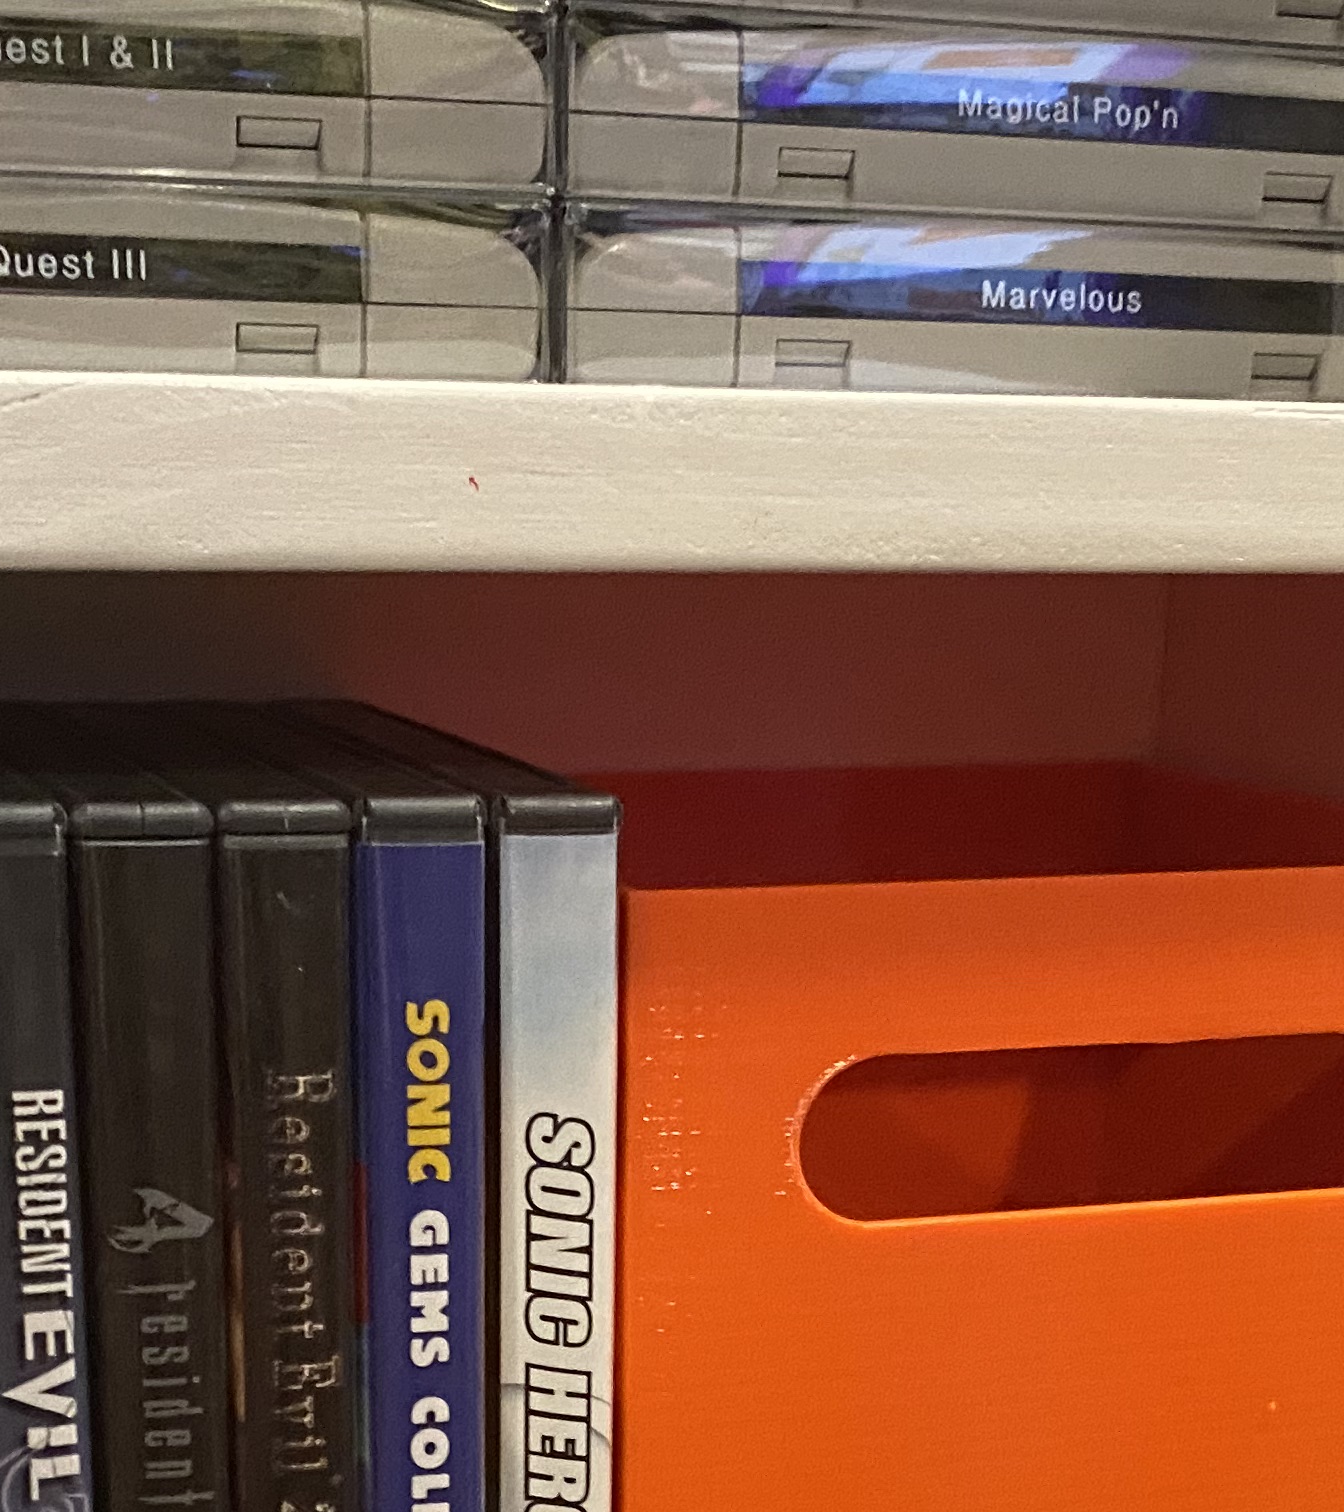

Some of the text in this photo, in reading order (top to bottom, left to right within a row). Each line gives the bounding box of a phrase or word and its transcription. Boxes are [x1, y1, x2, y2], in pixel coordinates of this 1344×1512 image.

[82, 36, 90, 66] I
[108, 37, 135, 69] &
[151, 39, 175, 71] II
[957, 88, 1179, 132] Magical Pop'n
[111, 248, 147, 282] III
[981, 280, 1143, 315] Marvelous
[403, 999, 452, 1184] SONIC
[264, 1068, 339, 1341] Resident
[407, 1209, 452, 1367] GEMS
[523, 1111, 596, 1349] SONIC
[0, 1088, 79, 1502] RESIDENT EVIL
[122, 1277, 217, 1508] resident
